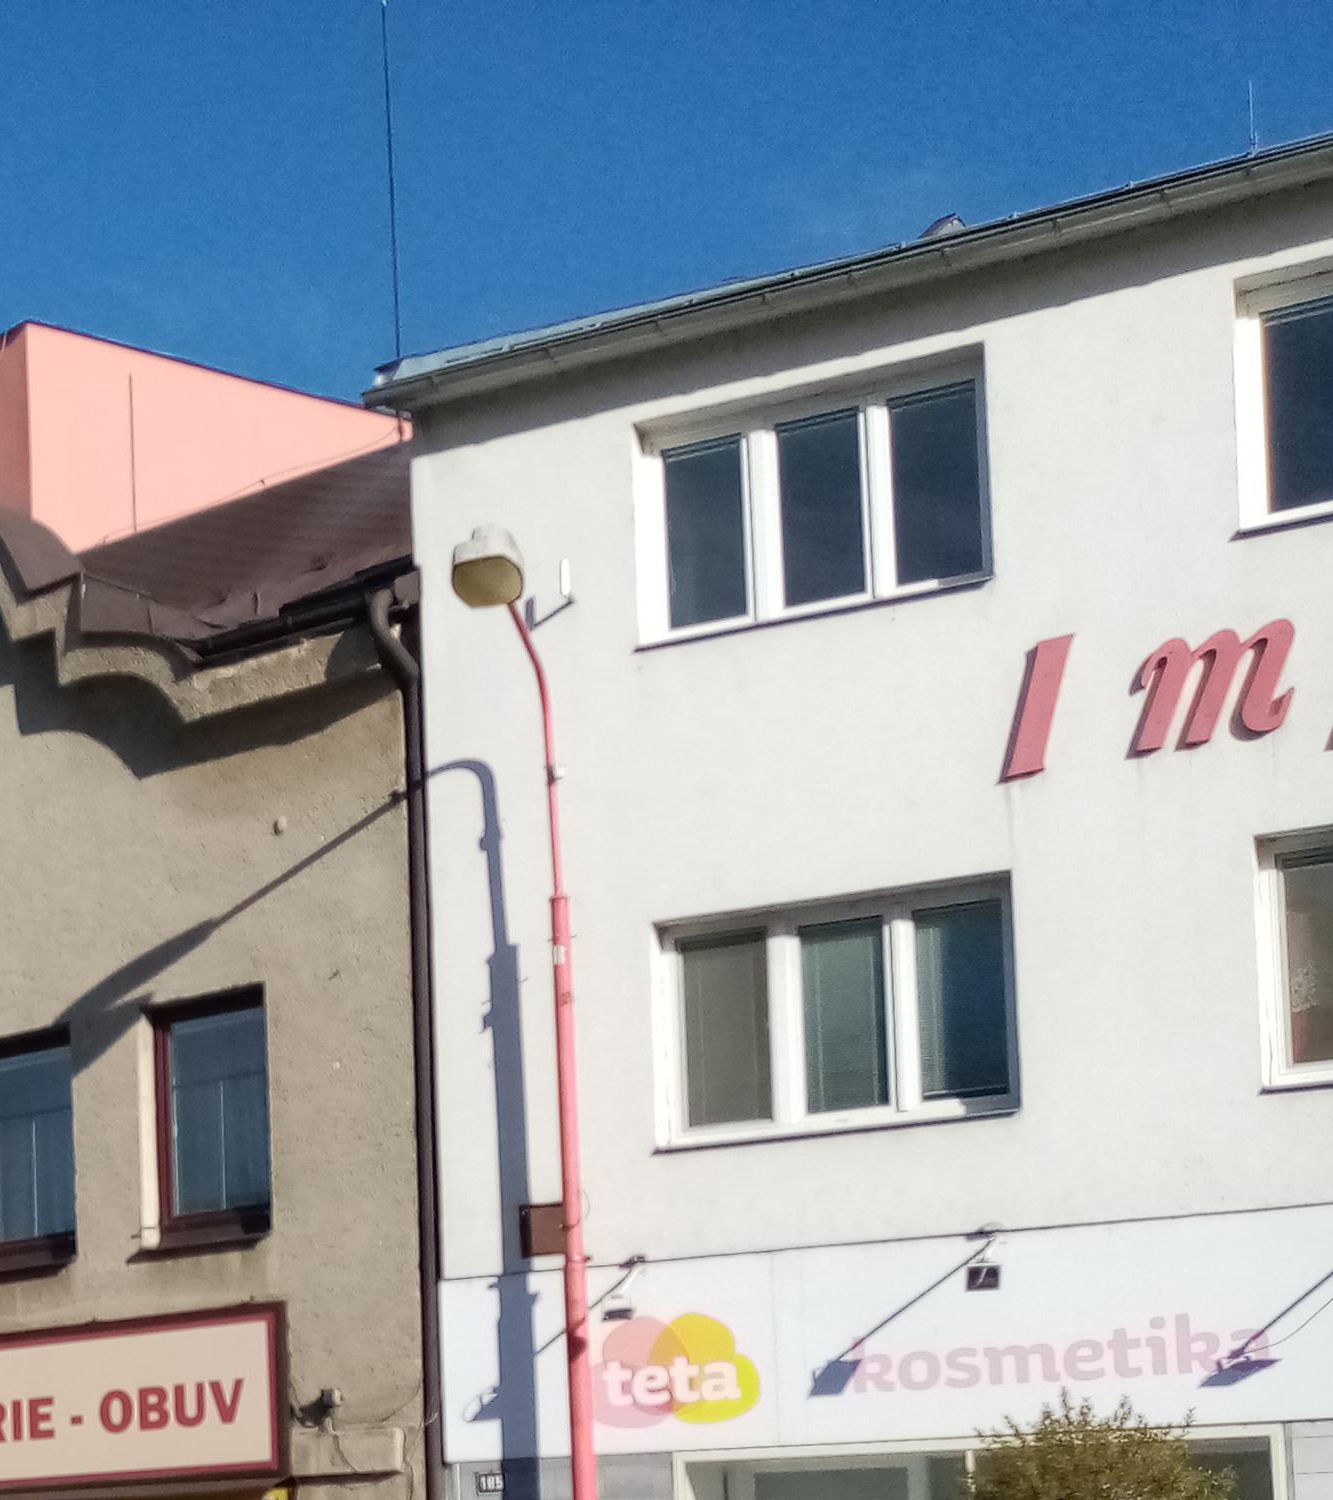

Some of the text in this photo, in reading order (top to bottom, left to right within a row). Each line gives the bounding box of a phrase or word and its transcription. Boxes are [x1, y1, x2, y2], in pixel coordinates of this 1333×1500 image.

[999, 617, 1333, 785] Im
[602, 1355, 742, 1406] teta
[853, 1311, 1271, 1393] kosmetika
[98, 1377, 245, 1435] OBUV
